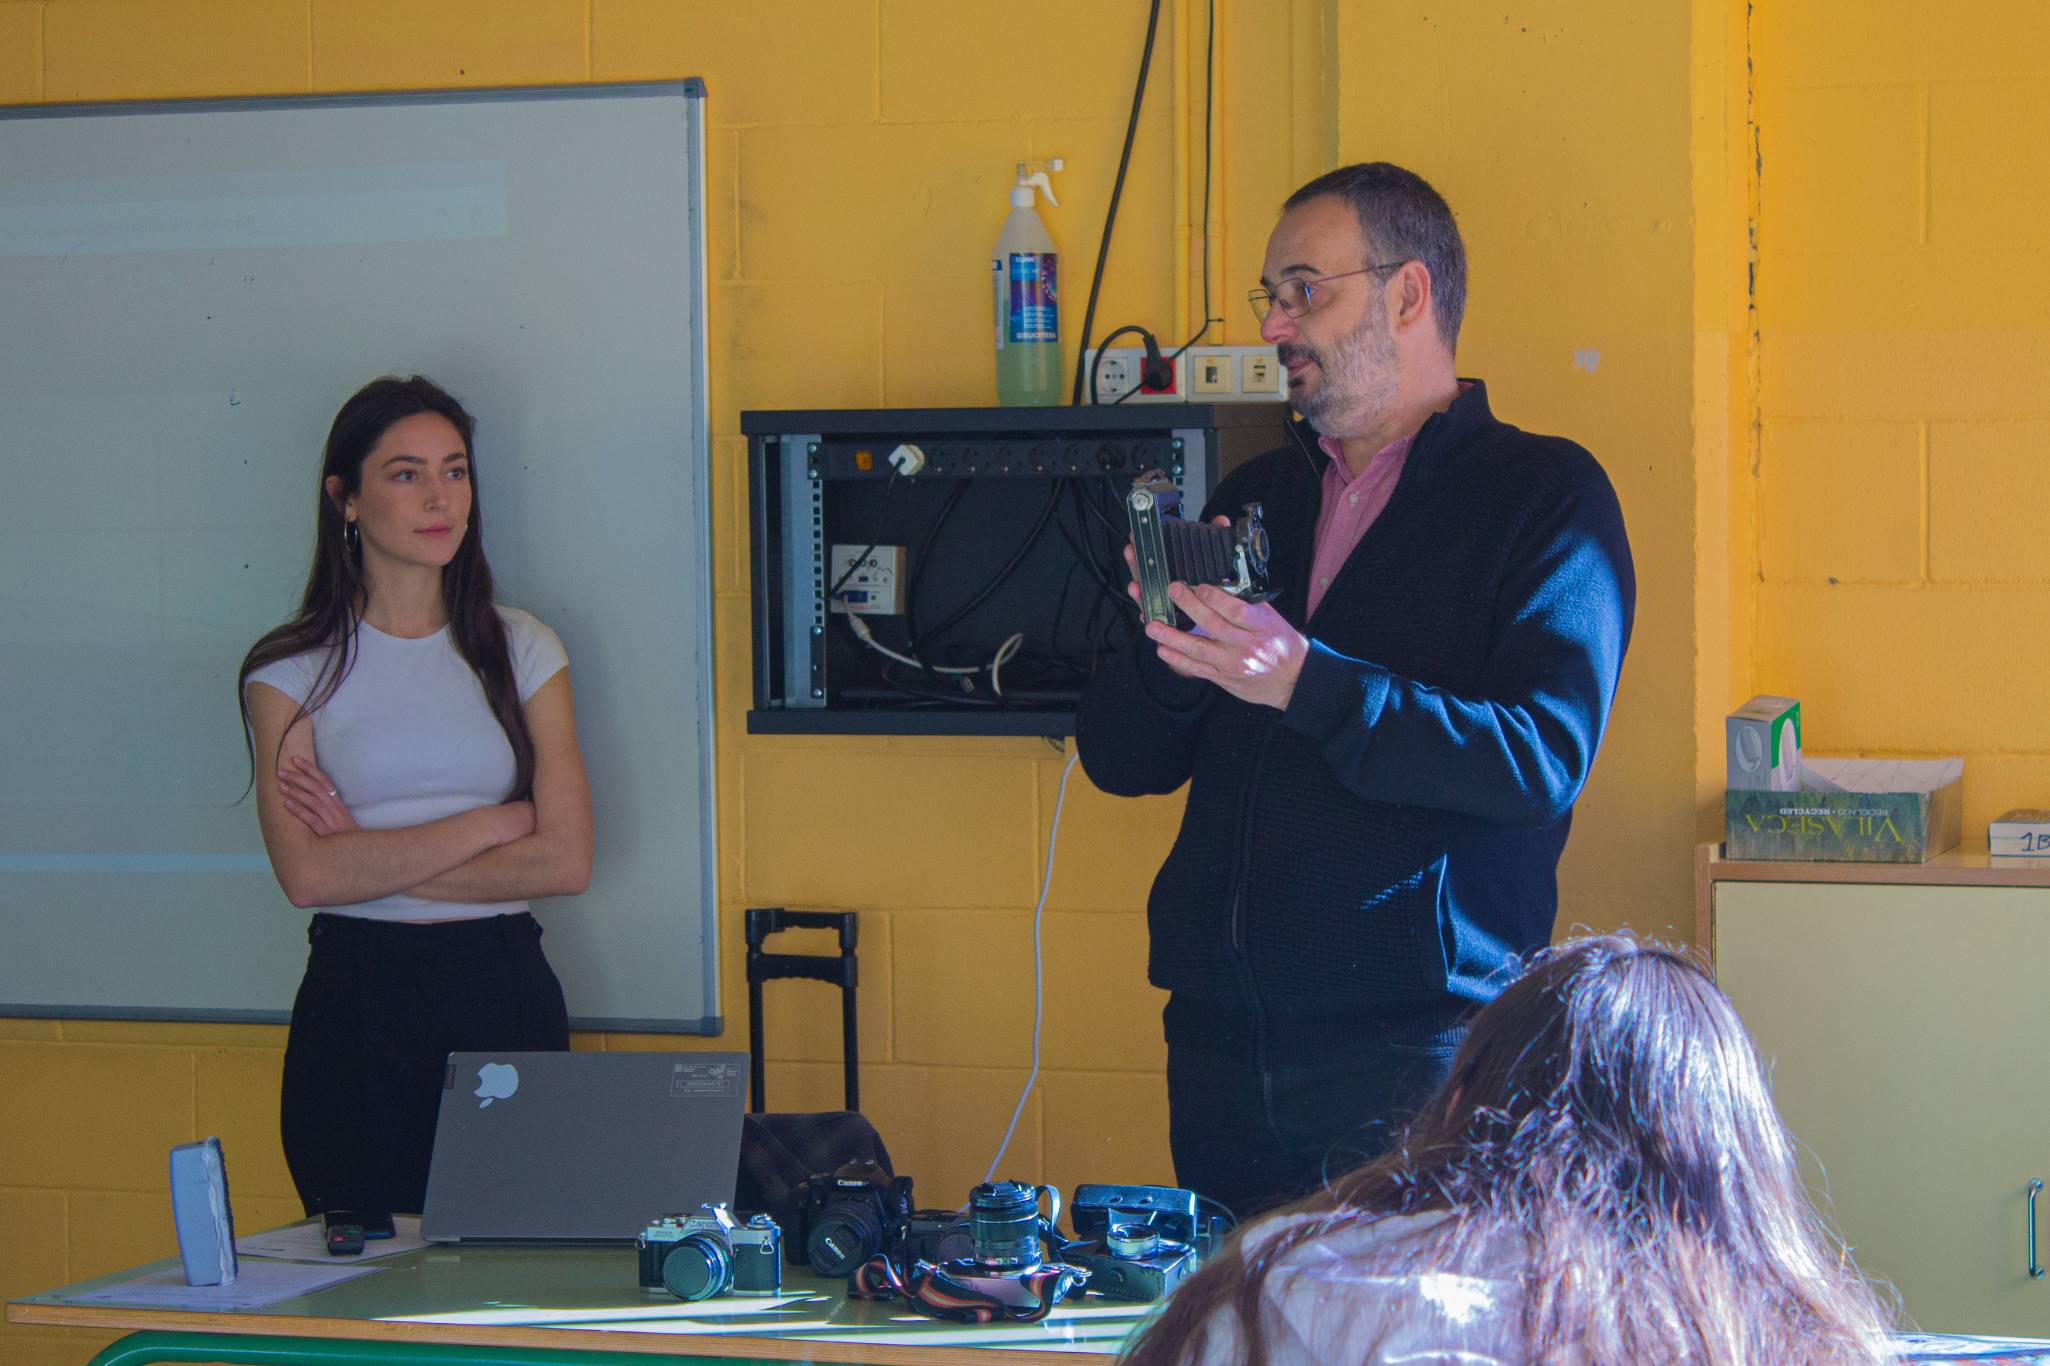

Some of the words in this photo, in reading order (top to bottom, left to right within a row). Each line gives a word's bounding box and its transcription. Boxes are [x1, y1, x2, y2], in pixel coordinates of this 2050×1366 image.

[1779, 807, 1831, 816] RECYCLED
[1744, 813, 1903, 844] VILASECA
[837, 1179, 863, 1187] Canon
[825, 1237, 846, 1261] Canon
